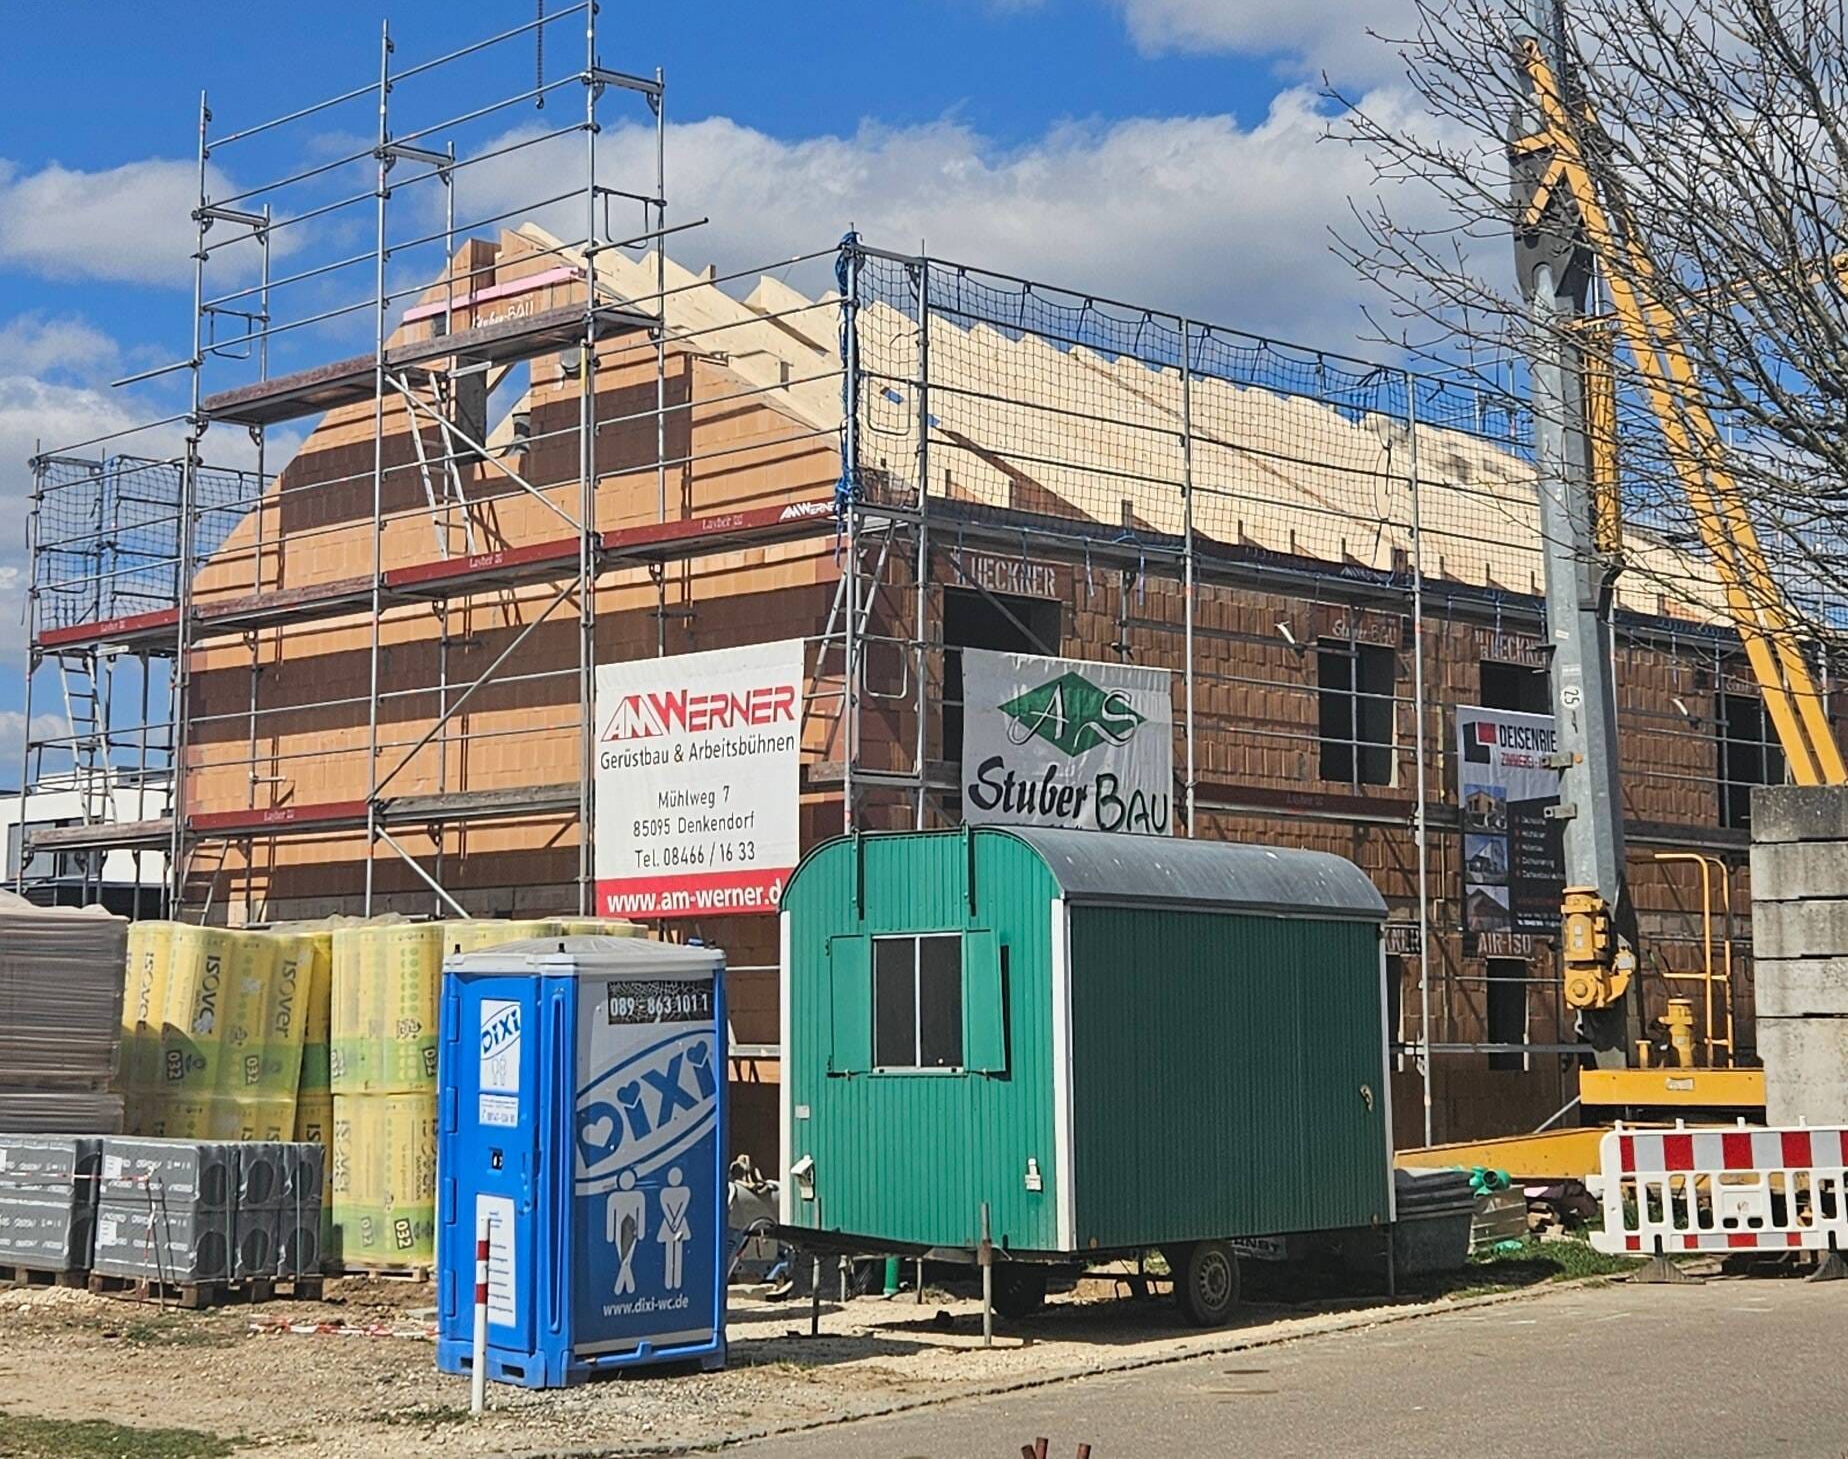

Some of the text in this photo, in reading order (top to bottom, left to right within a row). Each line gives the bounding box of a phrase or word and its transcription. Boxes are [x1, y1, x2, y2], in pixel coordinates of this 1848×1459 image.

[601, 733, 795, 769] Gerüstbau & Arbeitsbühnen
[1499, 724, 1557, 753] DEISENRIE
[658, 785, 730, 808] Mühlweg 7
[968, 755, 1088, 819] Stuber
[633, 811, 755, 837] 85095 Denkendorf
[635, 849, 659, 868] Tel.
[663, 845, 704, 866] 08466
[720, 842, 733, 862] 16
[738, 841, 755, 861] 33
[607, 878, 782, 913] www.am-werner.d
[610, 997, 635, 1017] 089
[396, 1221, 411, 1248] 032
[603, 1294, 689, 1316] www.dixi-wc.de
